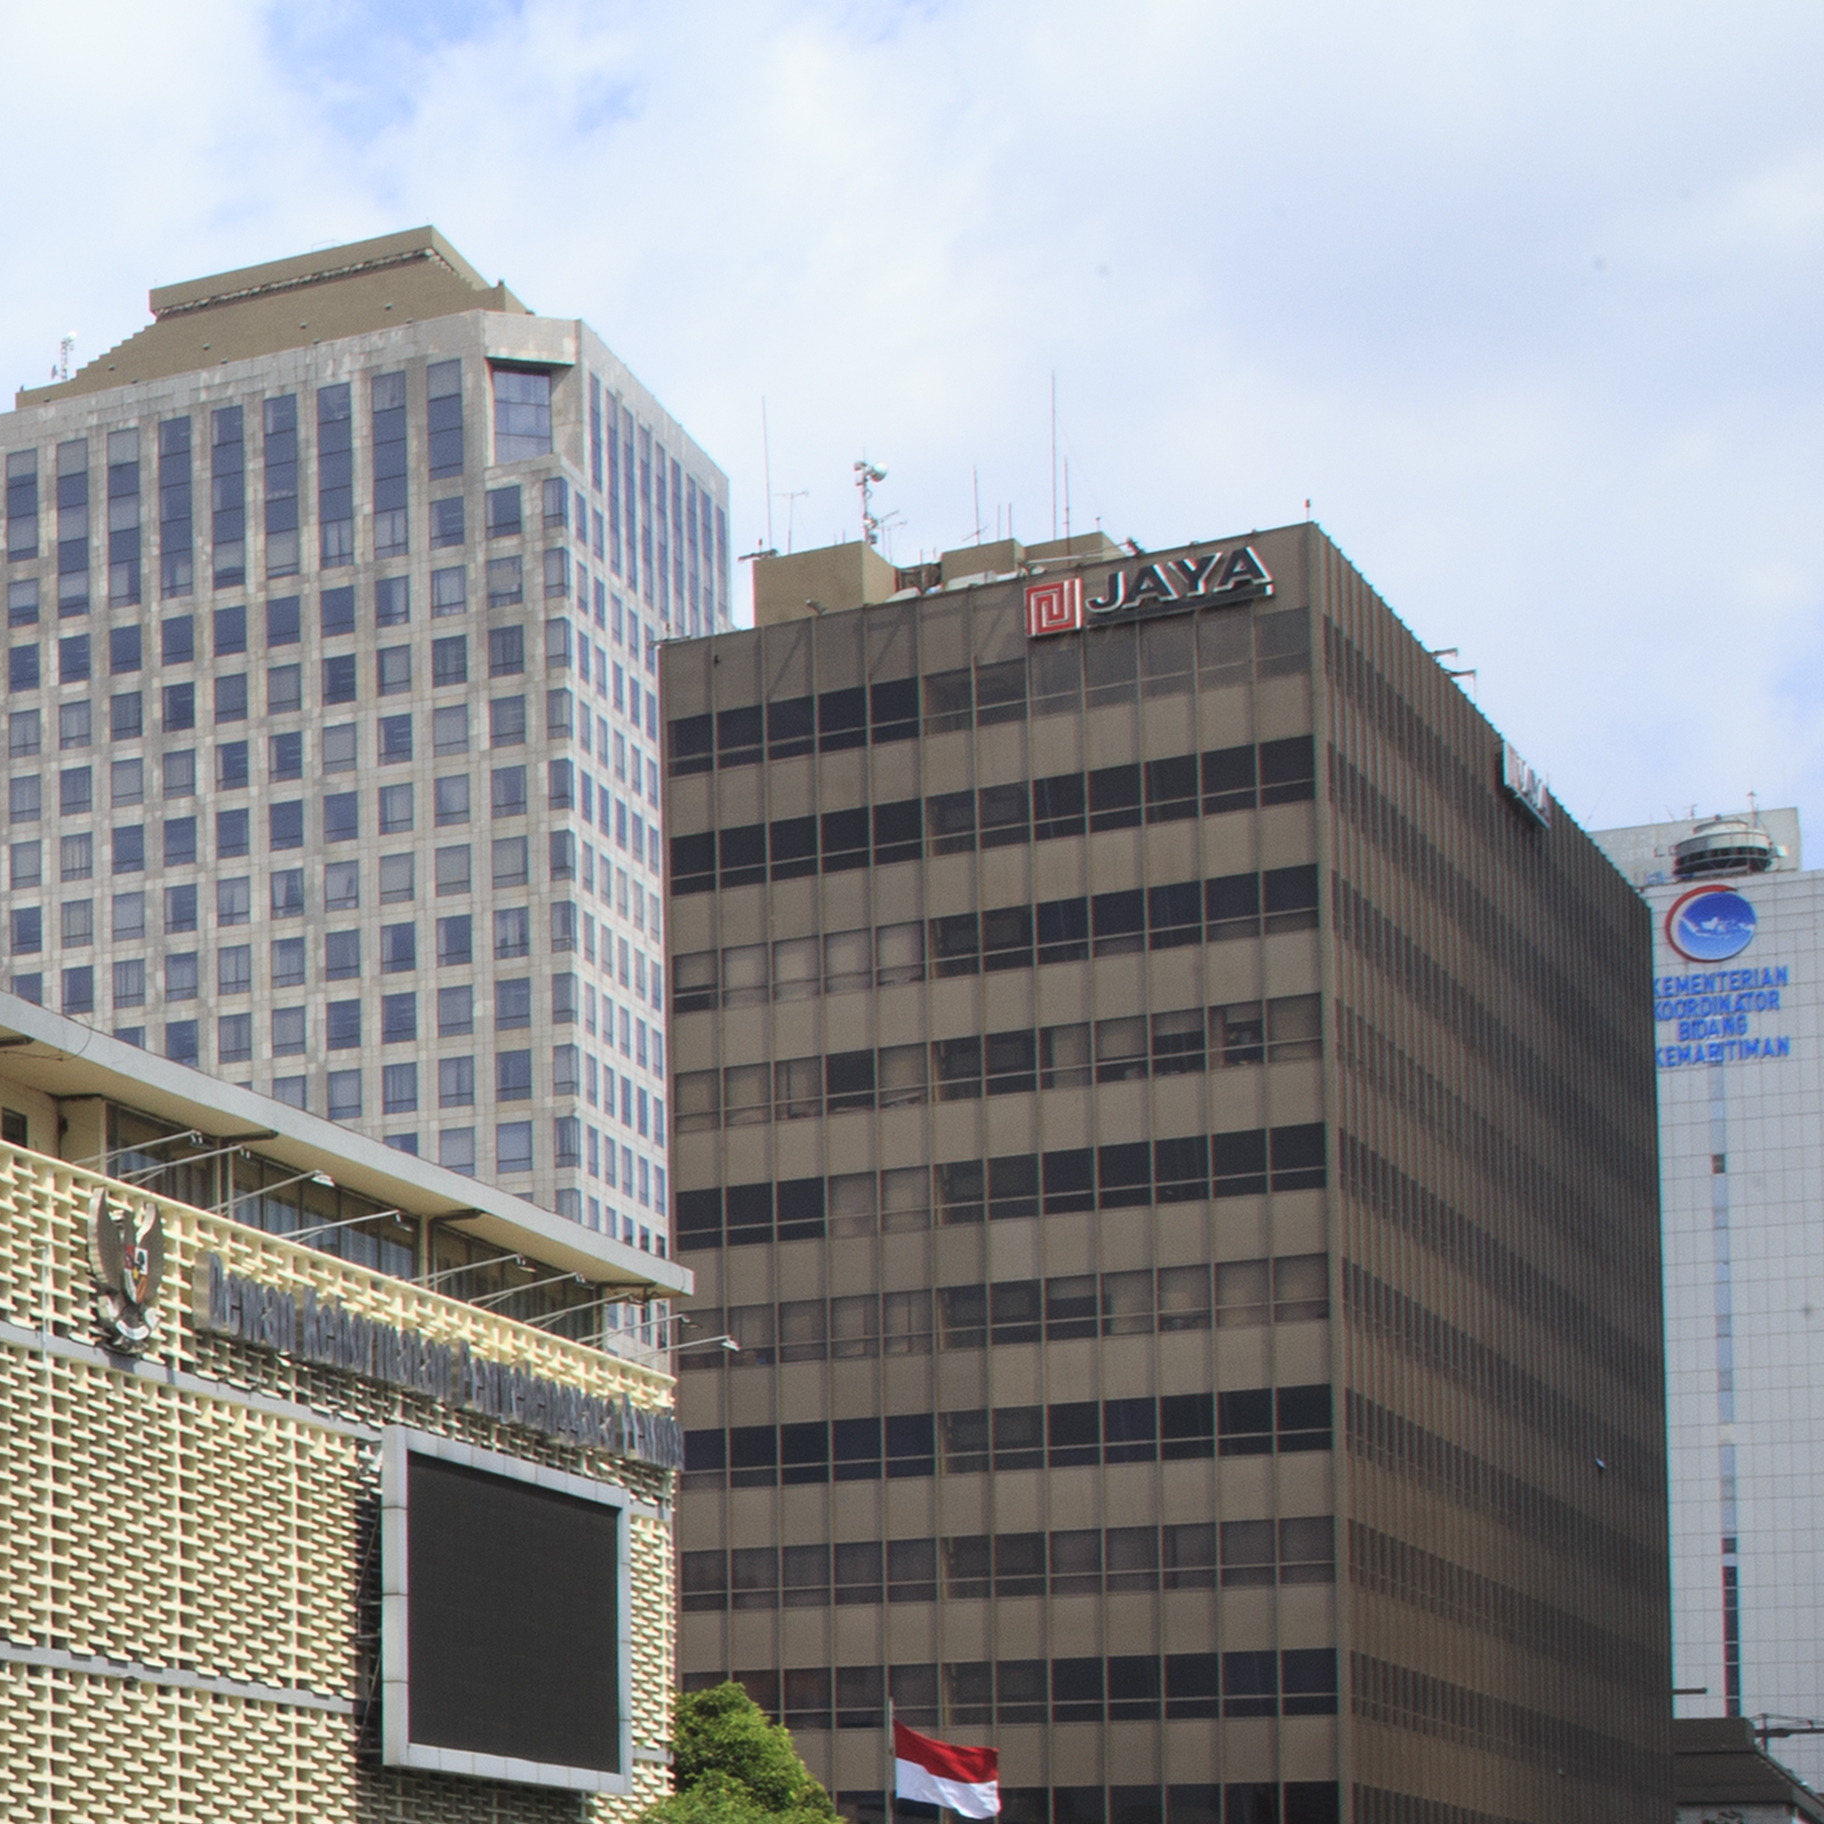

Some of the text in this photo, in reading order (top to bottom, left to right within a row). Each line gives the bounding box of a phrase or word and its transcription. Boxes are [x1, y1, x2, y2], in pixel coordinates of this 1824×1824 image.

[1085, 546, 1274, 613] JAYA
[1654, 964, 1789, 999] KEMENTERIAN
[1654, 989, 1780, 1022] KOORDINATOR
[1678, 1014, 1748, 1042] BIDANG
[1656, 1037, 1790, 1069] KEMARITIMAN
[202, 1252, 297, 1354] Dewan
[302, 1282, 452, 1403] Kehormatan
